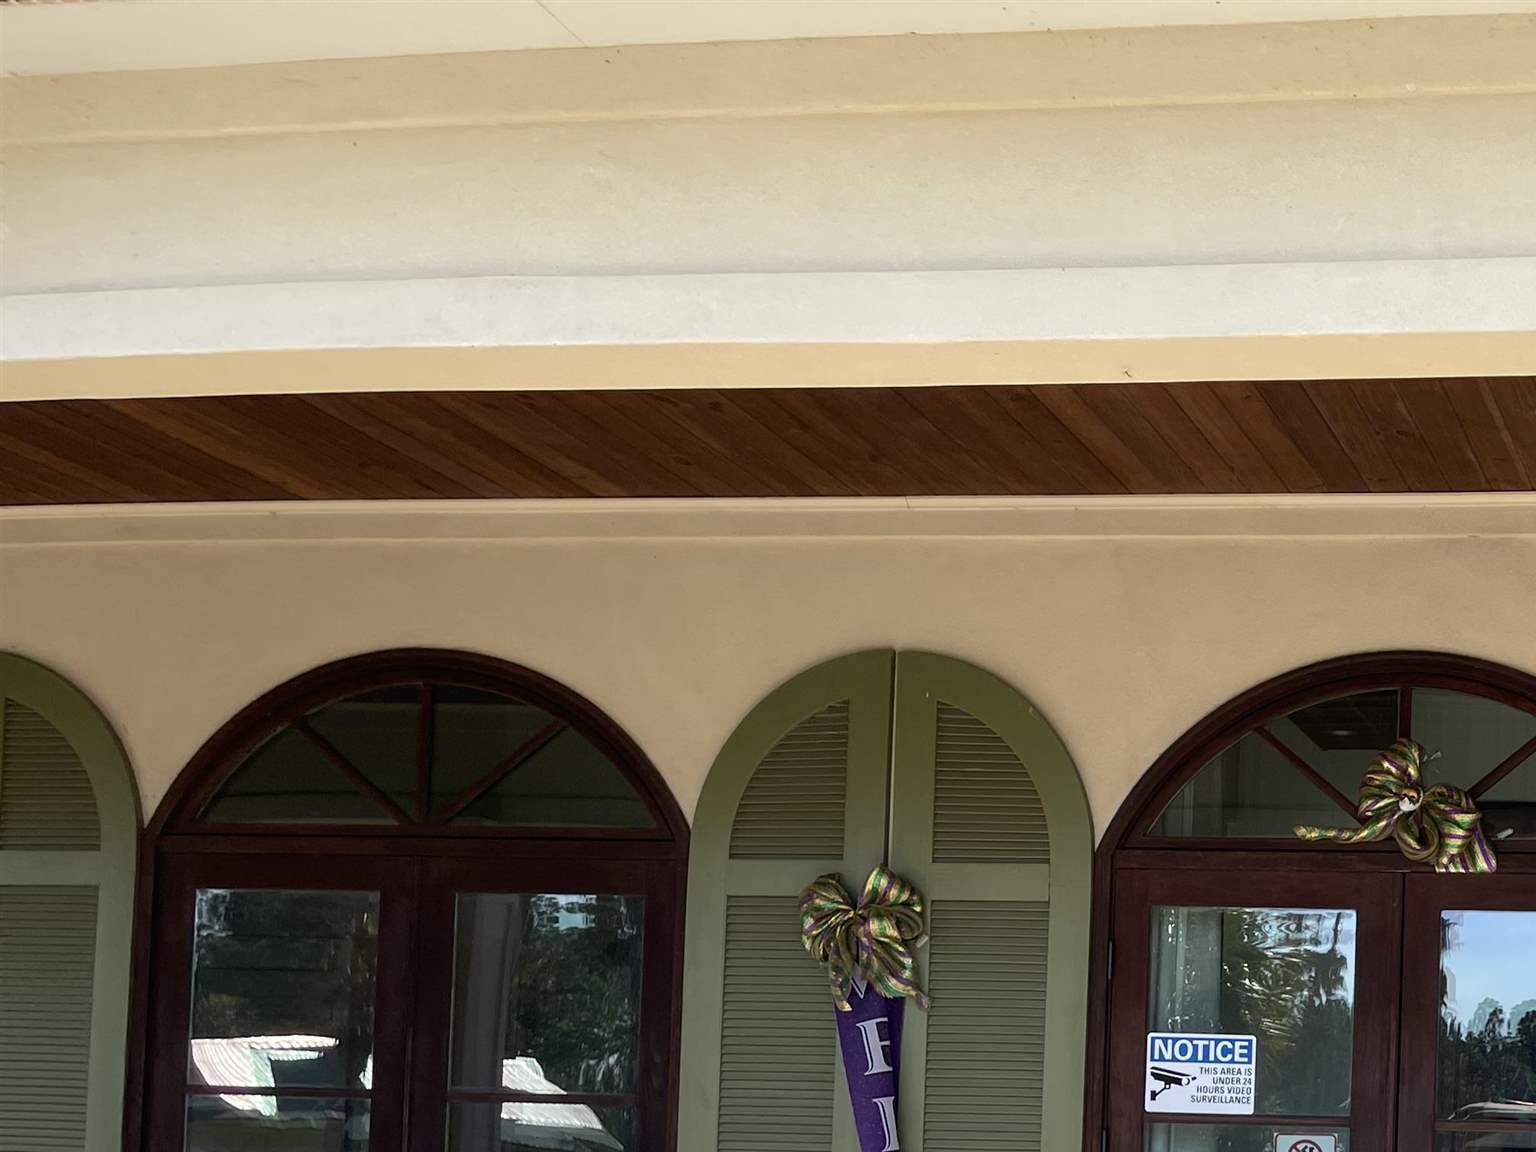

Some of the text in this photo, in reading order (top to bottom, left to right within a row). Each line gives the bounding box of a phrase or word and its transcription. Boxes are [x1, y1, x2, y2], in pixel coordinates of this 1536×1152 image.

[1153, 1038, 1249, 1062] NOTICE
[1200, 1067, 1253, 1076] THIS AREA IS
[1213, 1077, 1252, 1085] UNDER 24
[1196, 1086, 1252, 1095] HOURS VIDEO
[1190, 1095, 1251, 1104] SURVEILLANCE
